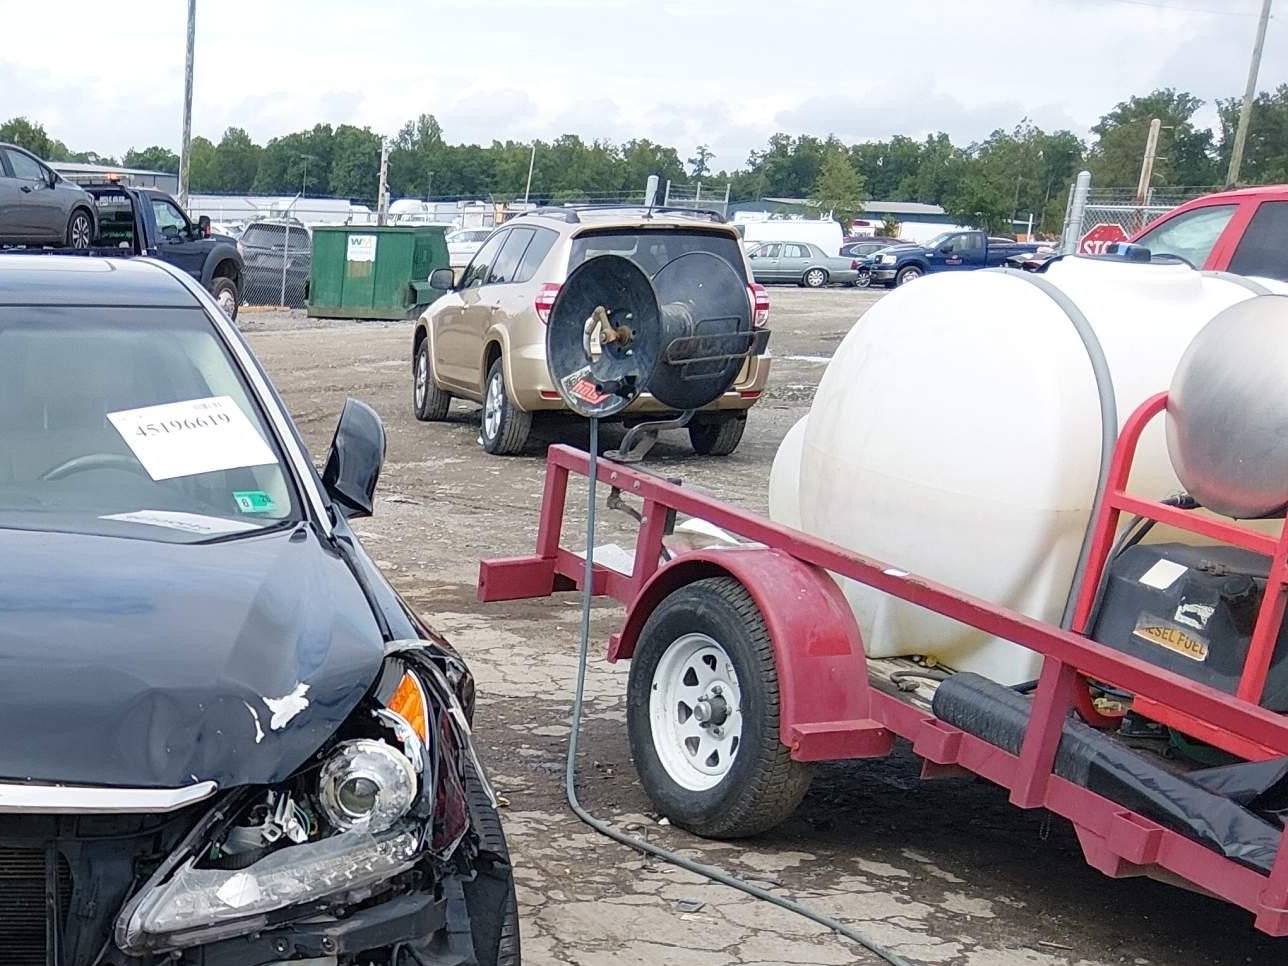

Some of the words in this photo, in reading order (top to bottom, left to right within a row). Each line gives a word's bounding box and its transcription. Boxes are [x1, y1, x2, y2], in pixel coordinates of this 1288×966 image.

[1083, 240, 1111, 255] ST
[135, 412, 232, 437] 45196619
[1177, 631, 1205, 655] FUEL
